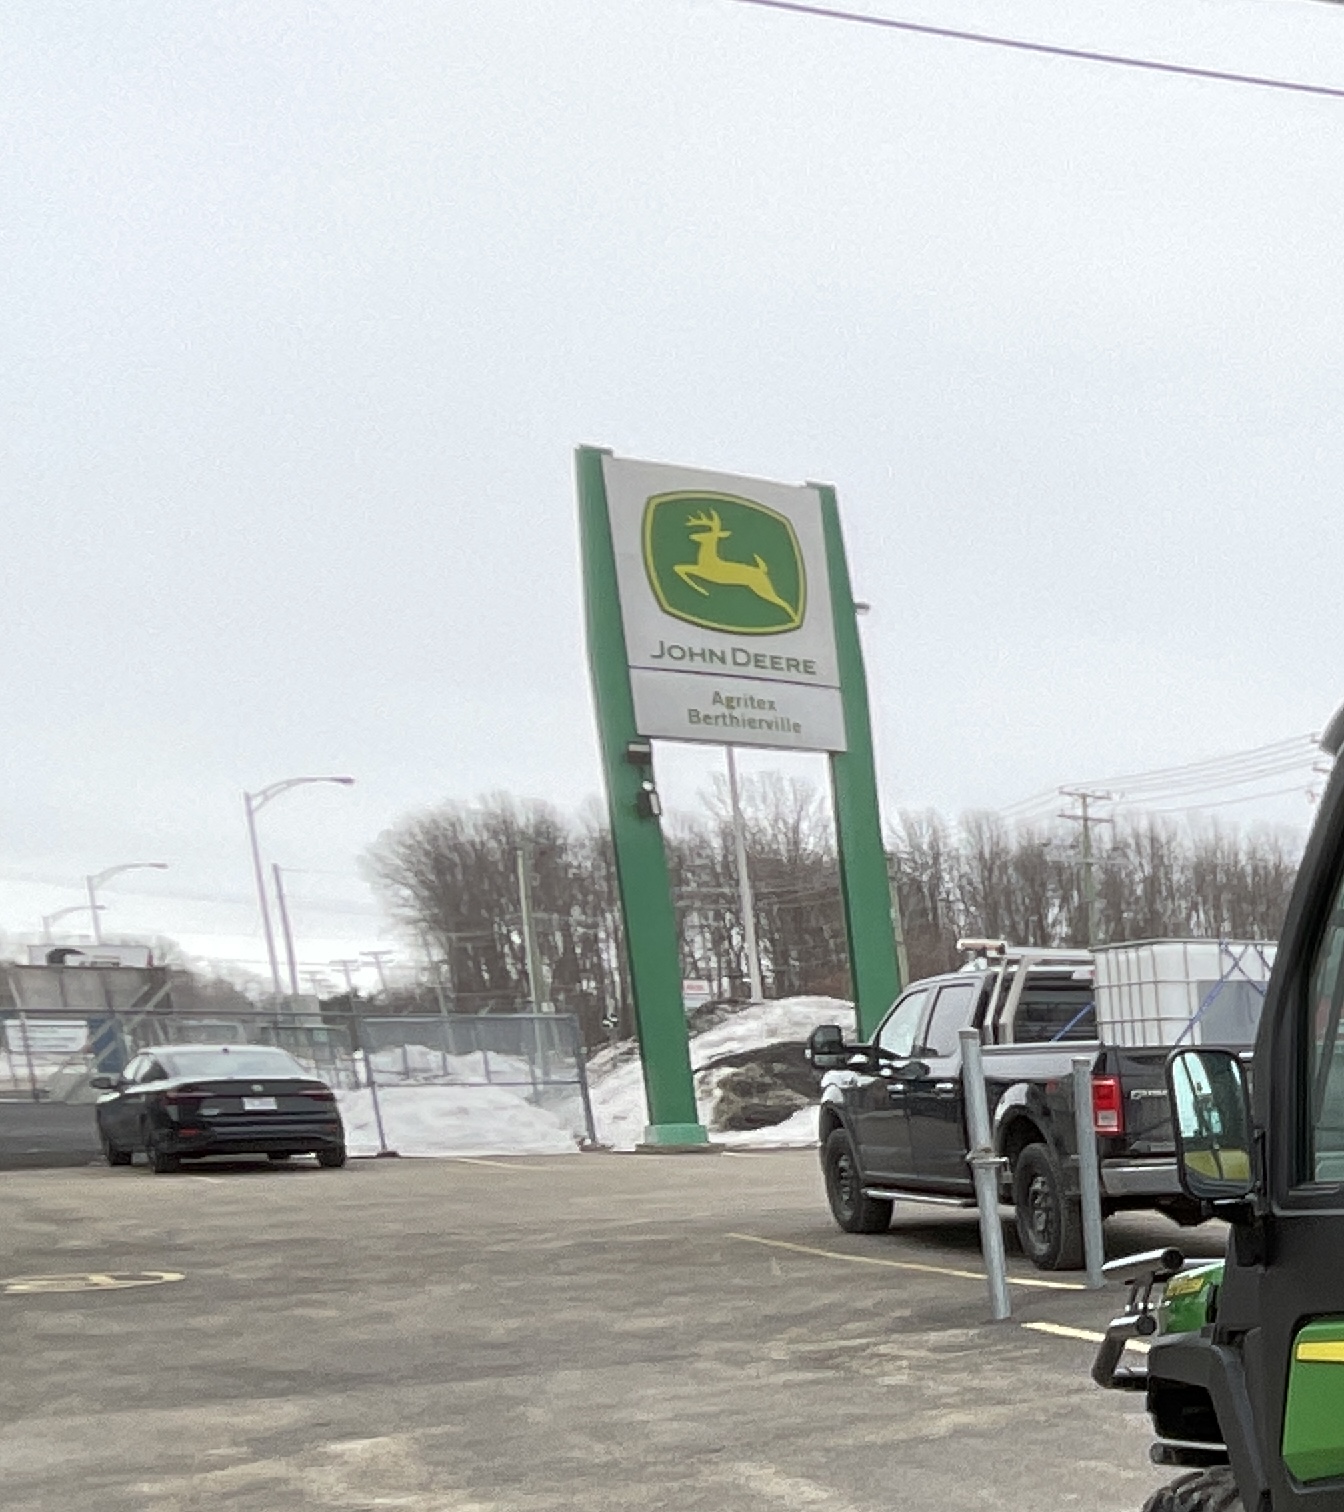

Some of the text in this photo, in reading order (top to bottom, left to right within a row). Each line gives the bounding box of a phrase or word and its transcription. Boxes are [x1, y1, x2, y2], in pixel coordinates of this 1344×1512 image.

[650, 640, 817, 675] JOHN DEERE
[712, 690, 778, 711] Agritex
[687, 708, 802, 734] Berthierville
